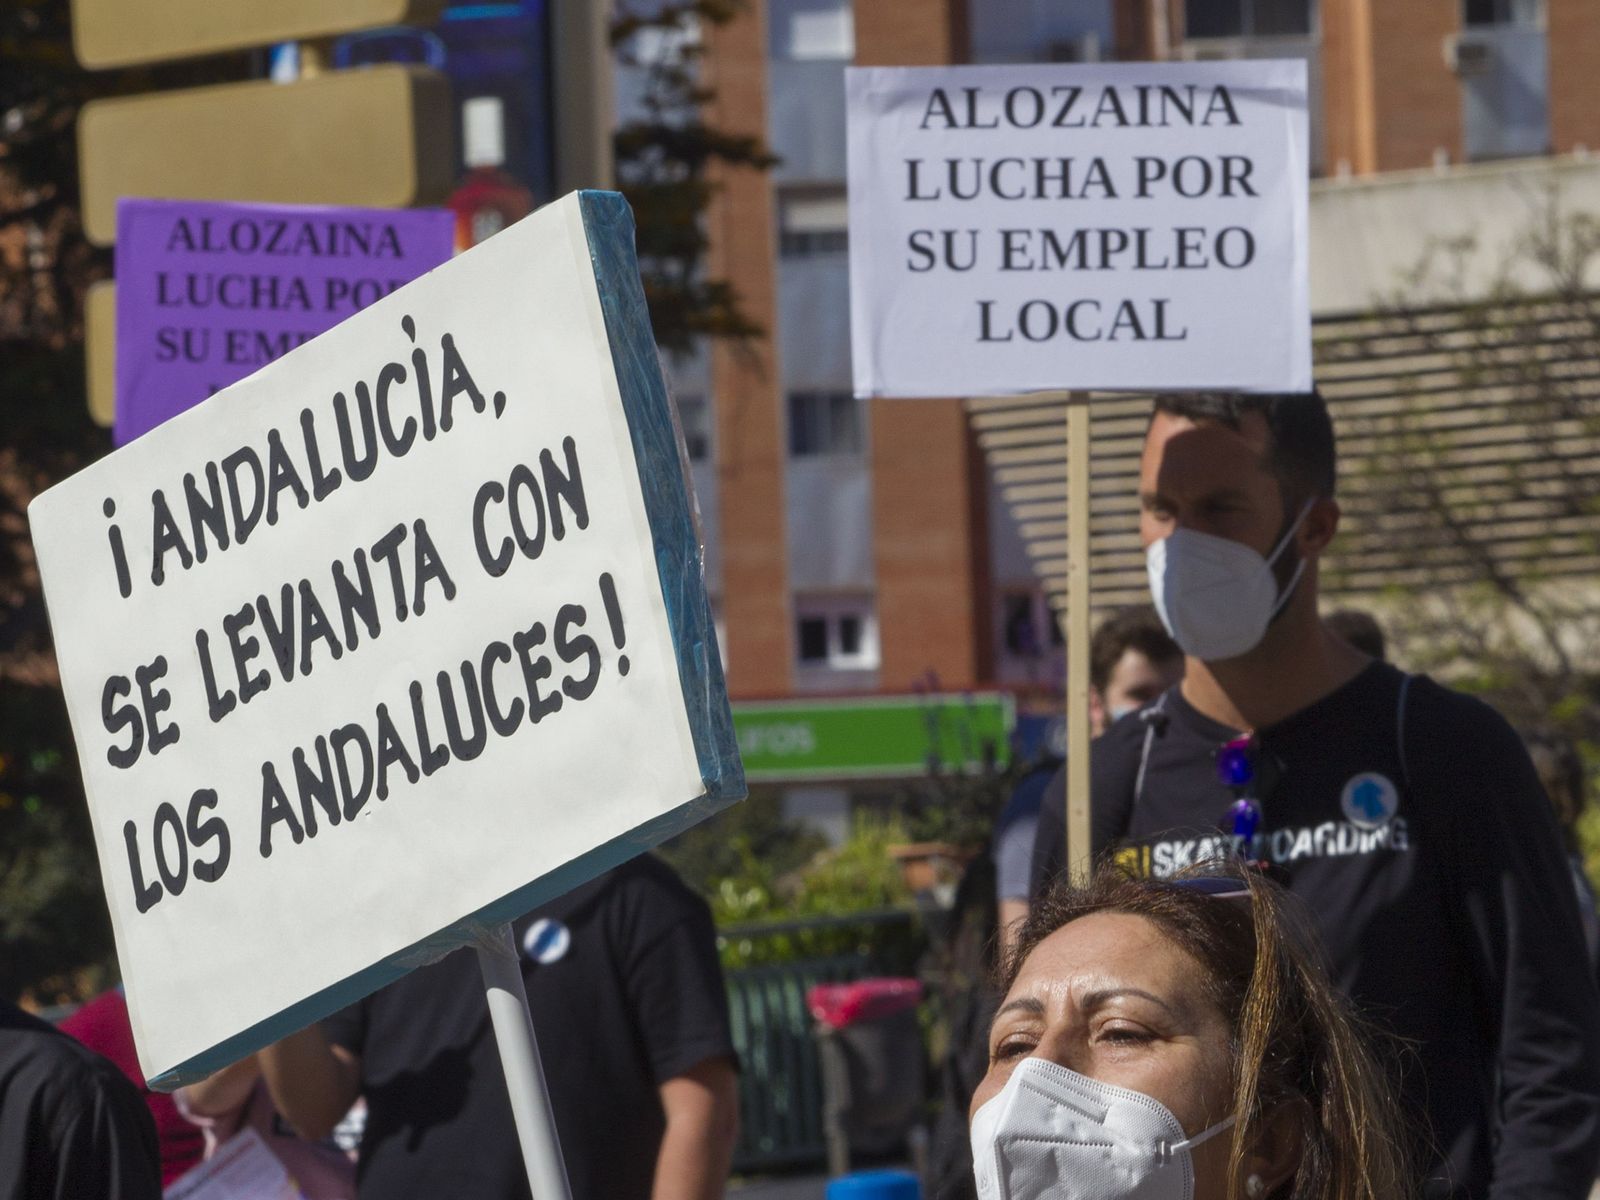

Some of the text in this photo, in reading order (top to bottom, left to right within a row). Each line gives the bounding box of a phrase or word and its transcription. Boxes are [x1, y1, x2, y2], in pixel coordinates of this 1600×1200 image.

[918, 84, 1242, 130] ALOZAINA
[903, 154, 1260, 202] LUCHA POR
[165, 217, 405, 259] ALOZAINA
[906, 226, 1257, 273] SU EMPLEO
[155, 271, 314, 312] LUCHA
[976, 298, 1188, 342] LOCAL
[155, 326, 212, 363] SU
[101, 436, 589, 769] SE LEVANTA CON
[123, 789, 232, 914] LOS
